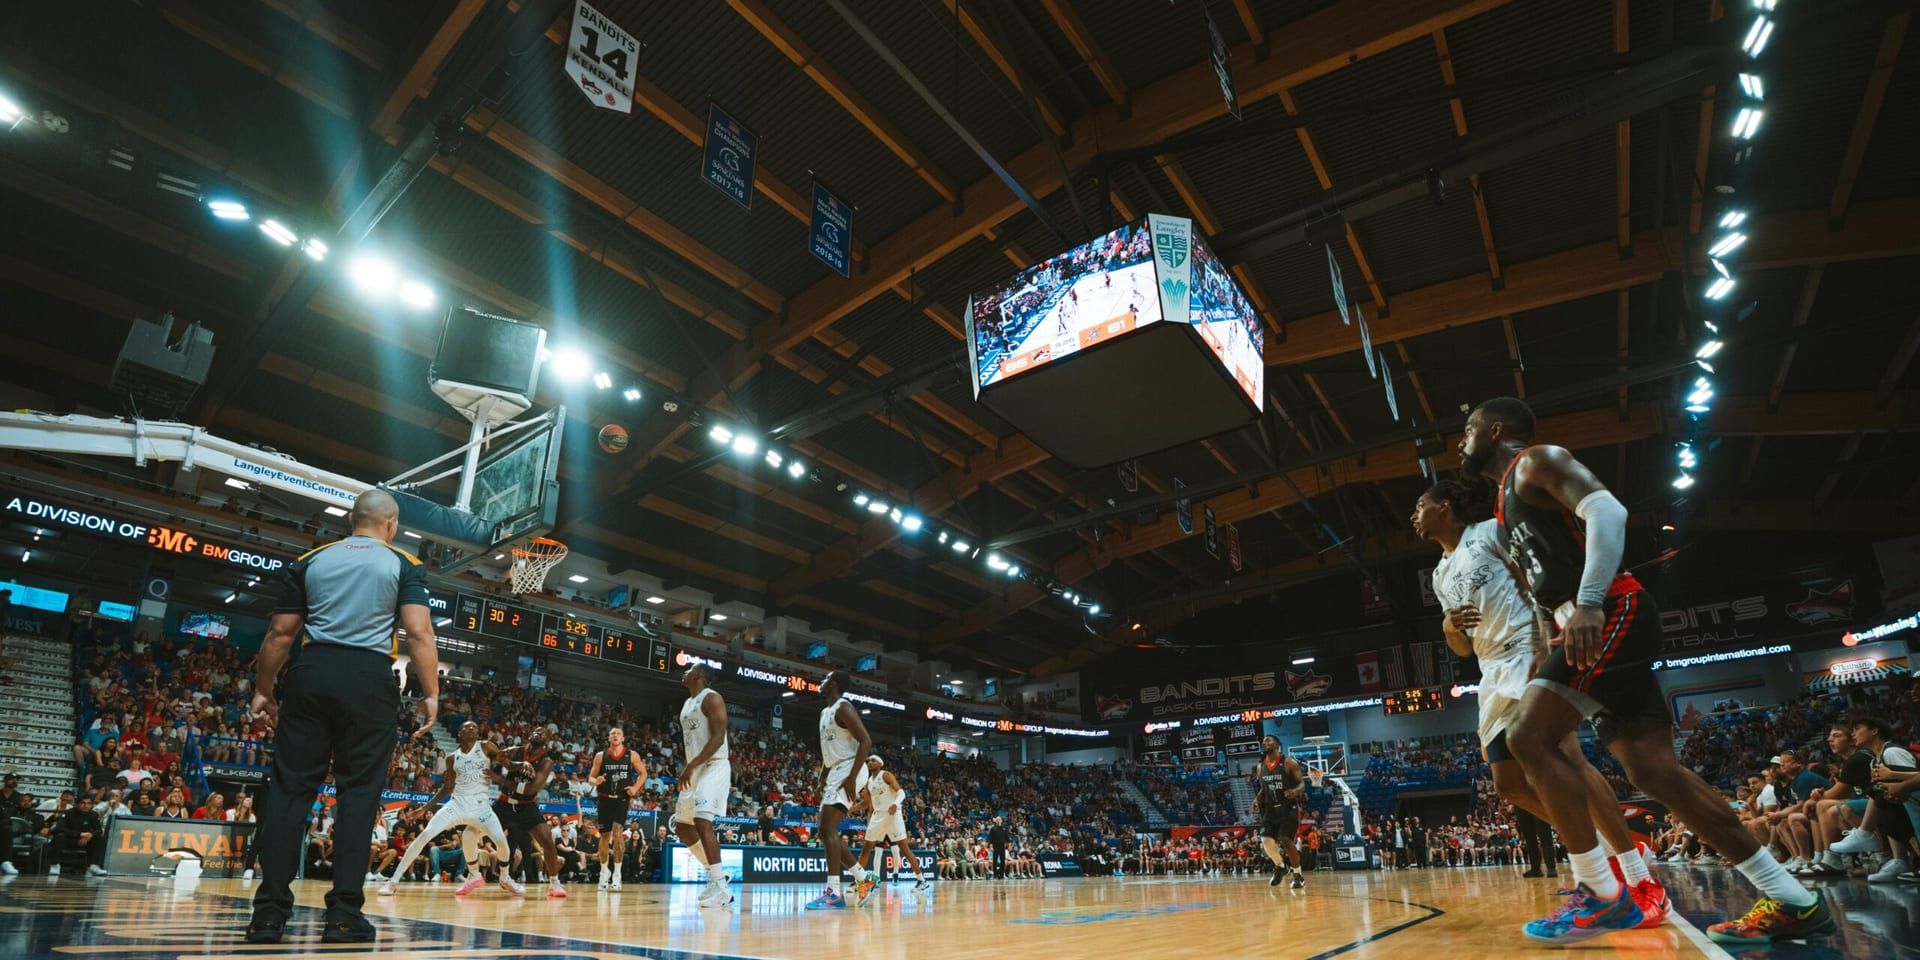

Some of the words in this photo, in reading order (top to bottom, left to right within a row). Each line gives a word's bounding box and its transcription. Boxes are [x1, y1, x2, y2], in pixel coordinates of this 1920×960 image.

[580, 6, 635, 52] BANDITS
[580, 26, 628, 81] 14
[573, 53, 629, 96] KENDALL
[711, 171, 743, 198] 2017-18
[6, 498, 22, 513] A
[26, 501, 115, 533] DIVISION
[119, 523, 147, 539] OF
[202, 544, 283, 570] BMGROUP
[148, 579, 168, 600] Q
[468, 617, 476, 629] 3
[489, 609, 505, 623] 30
[511, 614, 520, 626] 2
[565, 619, 588, 636] 5:25
[543, 634, 558, 647] 86
[568, 640, 575, 649] 4
[584, 643, 599, 656] 81
[607, 636, 621, 649] 21
[626, 640, 633, 652] 3
[659, 659, 665, 670] 5
[1666, 643, 1791, 668] bmgroupinternational.com
[737, 666, 744, 676] A
[744, 668, 776, 683] DIVISION
[777, 675, 787, 685] OF
[1140, 671, 1276, 704] BANDITS
[1153, 696, 1264, 716] BASKETBALL
[1193, 718, 1199, 726] A
[1199, 714, 1230, 725] DIVISION
[1230, 713, 1241, 722] OF
[117, 829, 245, 858] LiUNA!
[202, 859, 225, 869] Feel
[753, 856, 795, 872] NORTH
